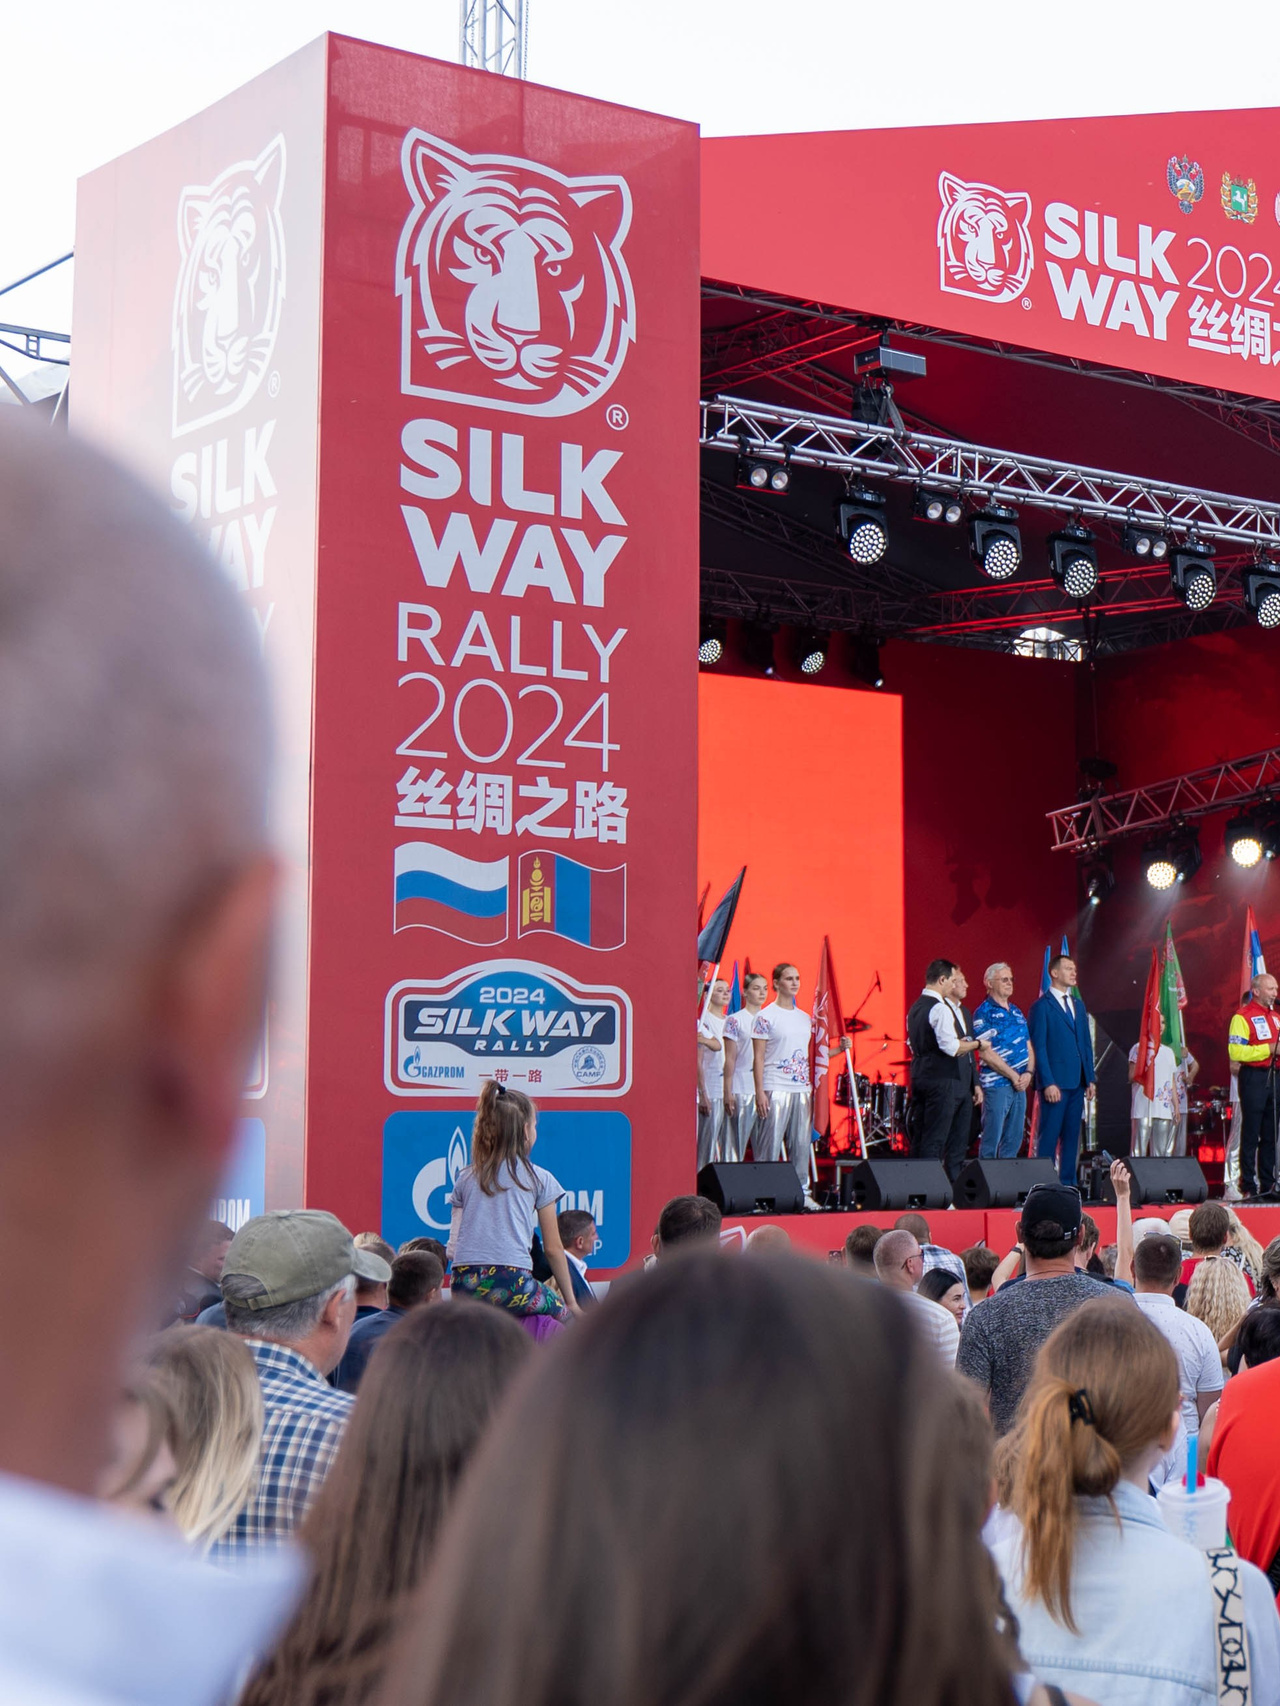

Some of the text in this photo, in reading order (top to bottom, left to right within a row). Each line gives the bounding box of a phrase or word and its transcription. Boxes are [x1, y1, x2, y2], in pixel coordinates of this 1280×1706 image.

[1045, 203, 1177, 286] SILK
[1044, 261, 1180, 341] WAY
[170, 418, 278, 525] SILK
[400, 418, 629, 527] SILK
[400, 504, 629, 608] WAY
[397, 602, 629, 683] RALLY
[396, 672, 621, 772] 2024
[394, 766, 630, 844] 丝绸之路
[414, 1007, 607, 1038] SILK WAY
[479, 986, 546, 1005] 2024
[421, 1065, 465, 1079] GAZPROM
[474, 1040, 550, 1052] RALLY
